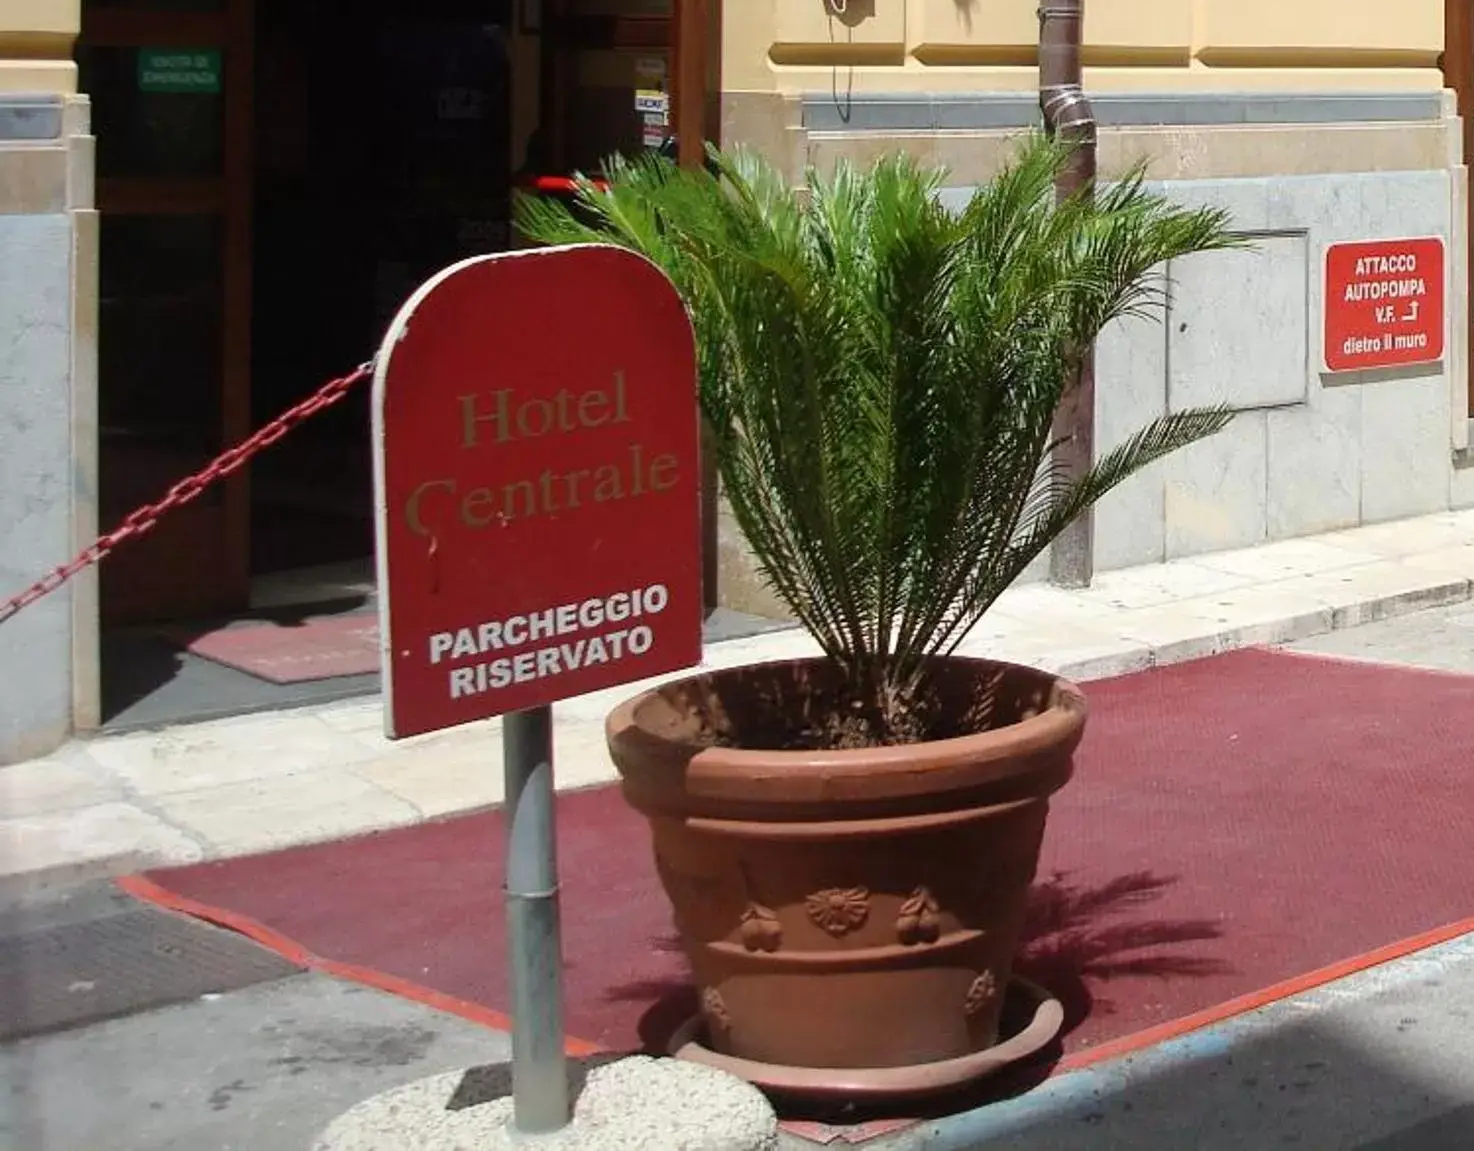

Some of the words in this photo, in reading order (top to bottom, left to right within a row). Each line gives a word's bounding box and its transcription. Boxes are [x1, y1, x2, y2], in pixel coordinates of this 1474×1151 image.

[1355, 254, 1416, 276] ATTACCO
[1344, 279, 1426, 302] AUTOPOMPA
[1375, 304, 1396, 323] V.F.
[1343, 336, 1381, 354] dietro
[1384, 333, 1393, 350] il
[1394, 332, 1427, 349] muro
[458, 371, 631, 446] Hotel
[405, 446, 679, 536] Centrale
[429, 584, 668, 664] PARCHEGGIO
[449, 626, 653, 698] RISERVATO
